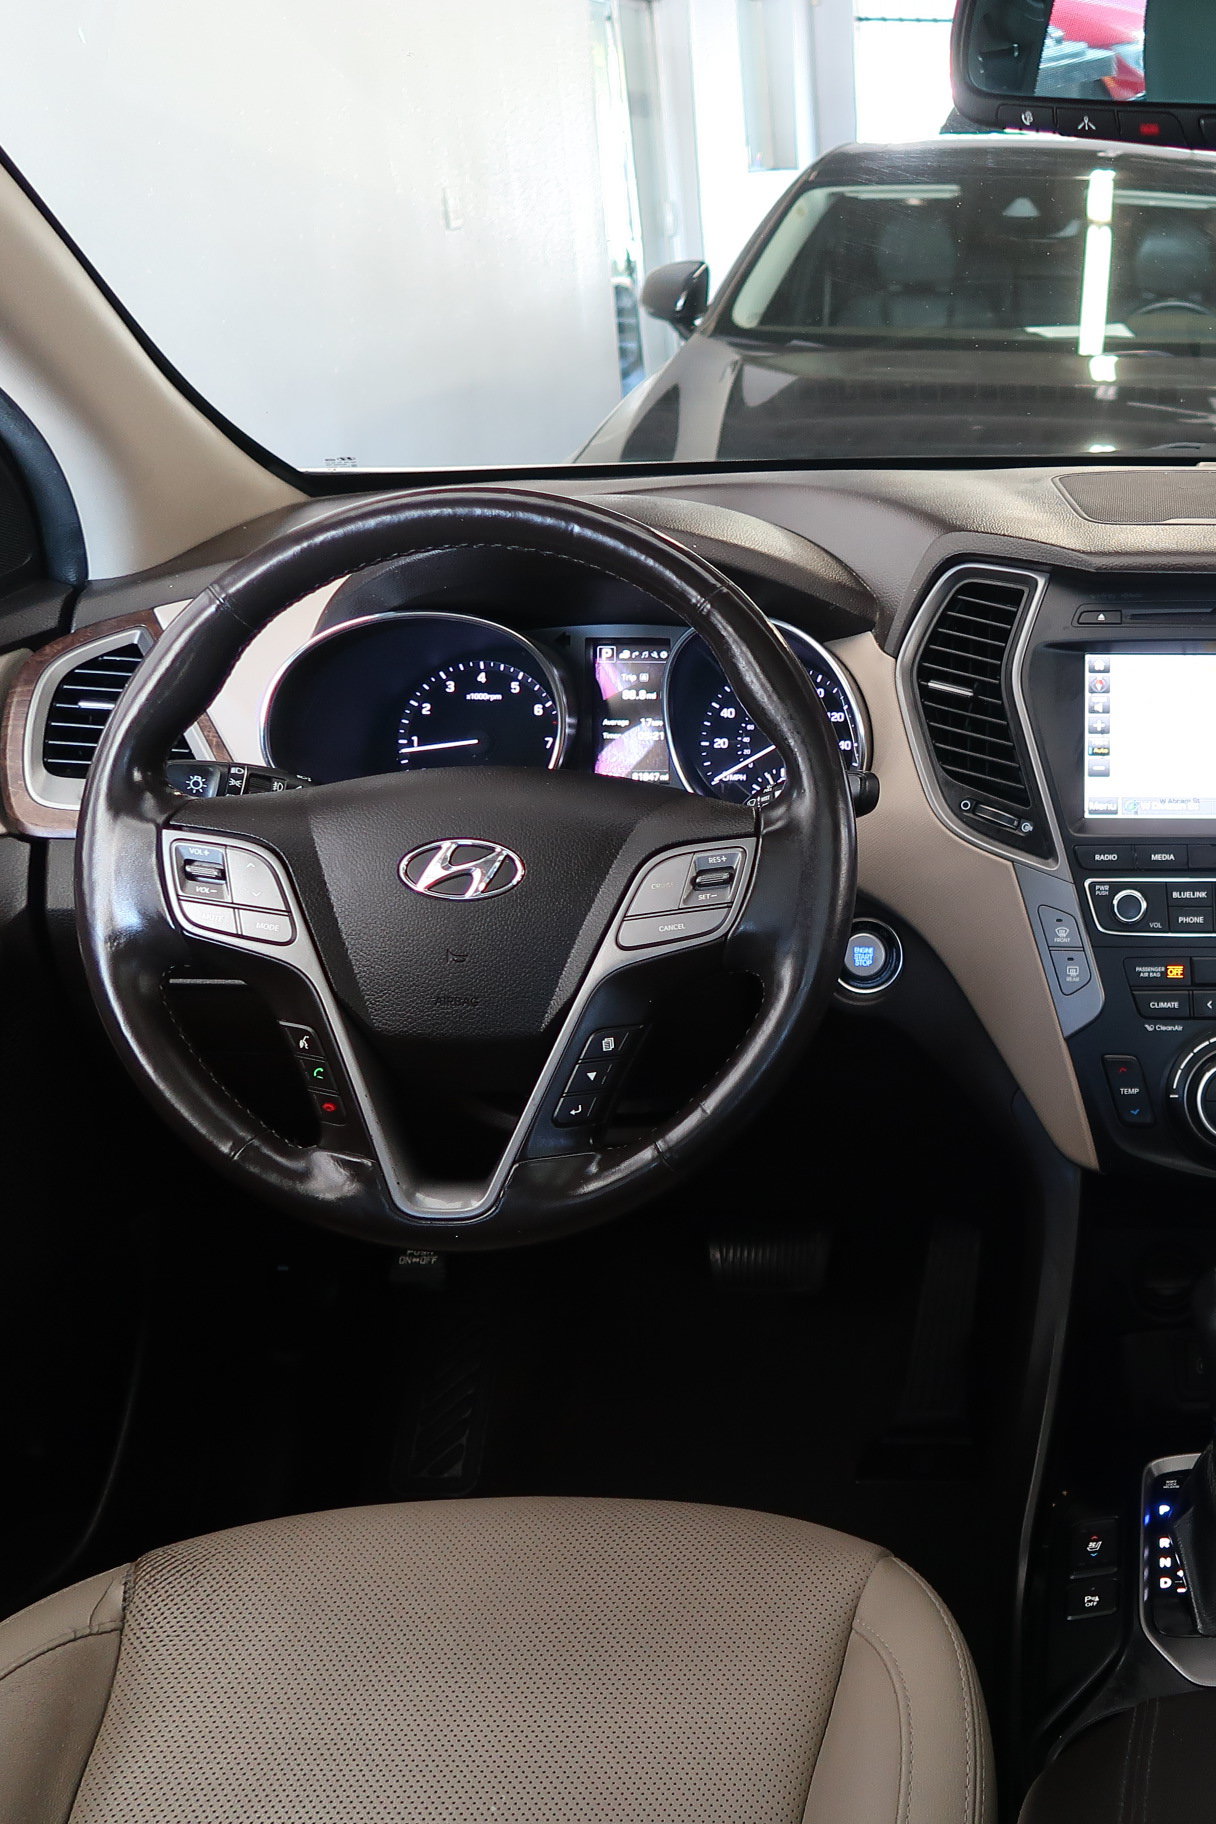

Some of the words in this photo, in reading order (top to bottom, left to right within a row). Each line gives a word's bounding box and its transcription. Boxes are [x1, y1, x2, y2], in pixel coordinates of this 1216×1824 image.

[601, 648, 612, 659] P
[477, 672, 486, 683] 4
[621, 673, 637, 683] Trip
[445, 681, 455, 692] 3
[510, 682, 520, 693] 5
[421, 703, 431, 714] 2
[534, 704, 544, 716] 6
[720, 708, 735, 718] 40
[544, 737, 553, 749] 7
[713, 738, 728, 748] 20
[658, 923, 685, 932] CANCEL
[1167, 968, 1184, 976] OFF
[1159, 1504, 1171, 1515] P
[1159, 1537, 1171, 1548] R
[1159, 1557, 1171, 1568] N
[1159, 1577, 1172, 1589] D
